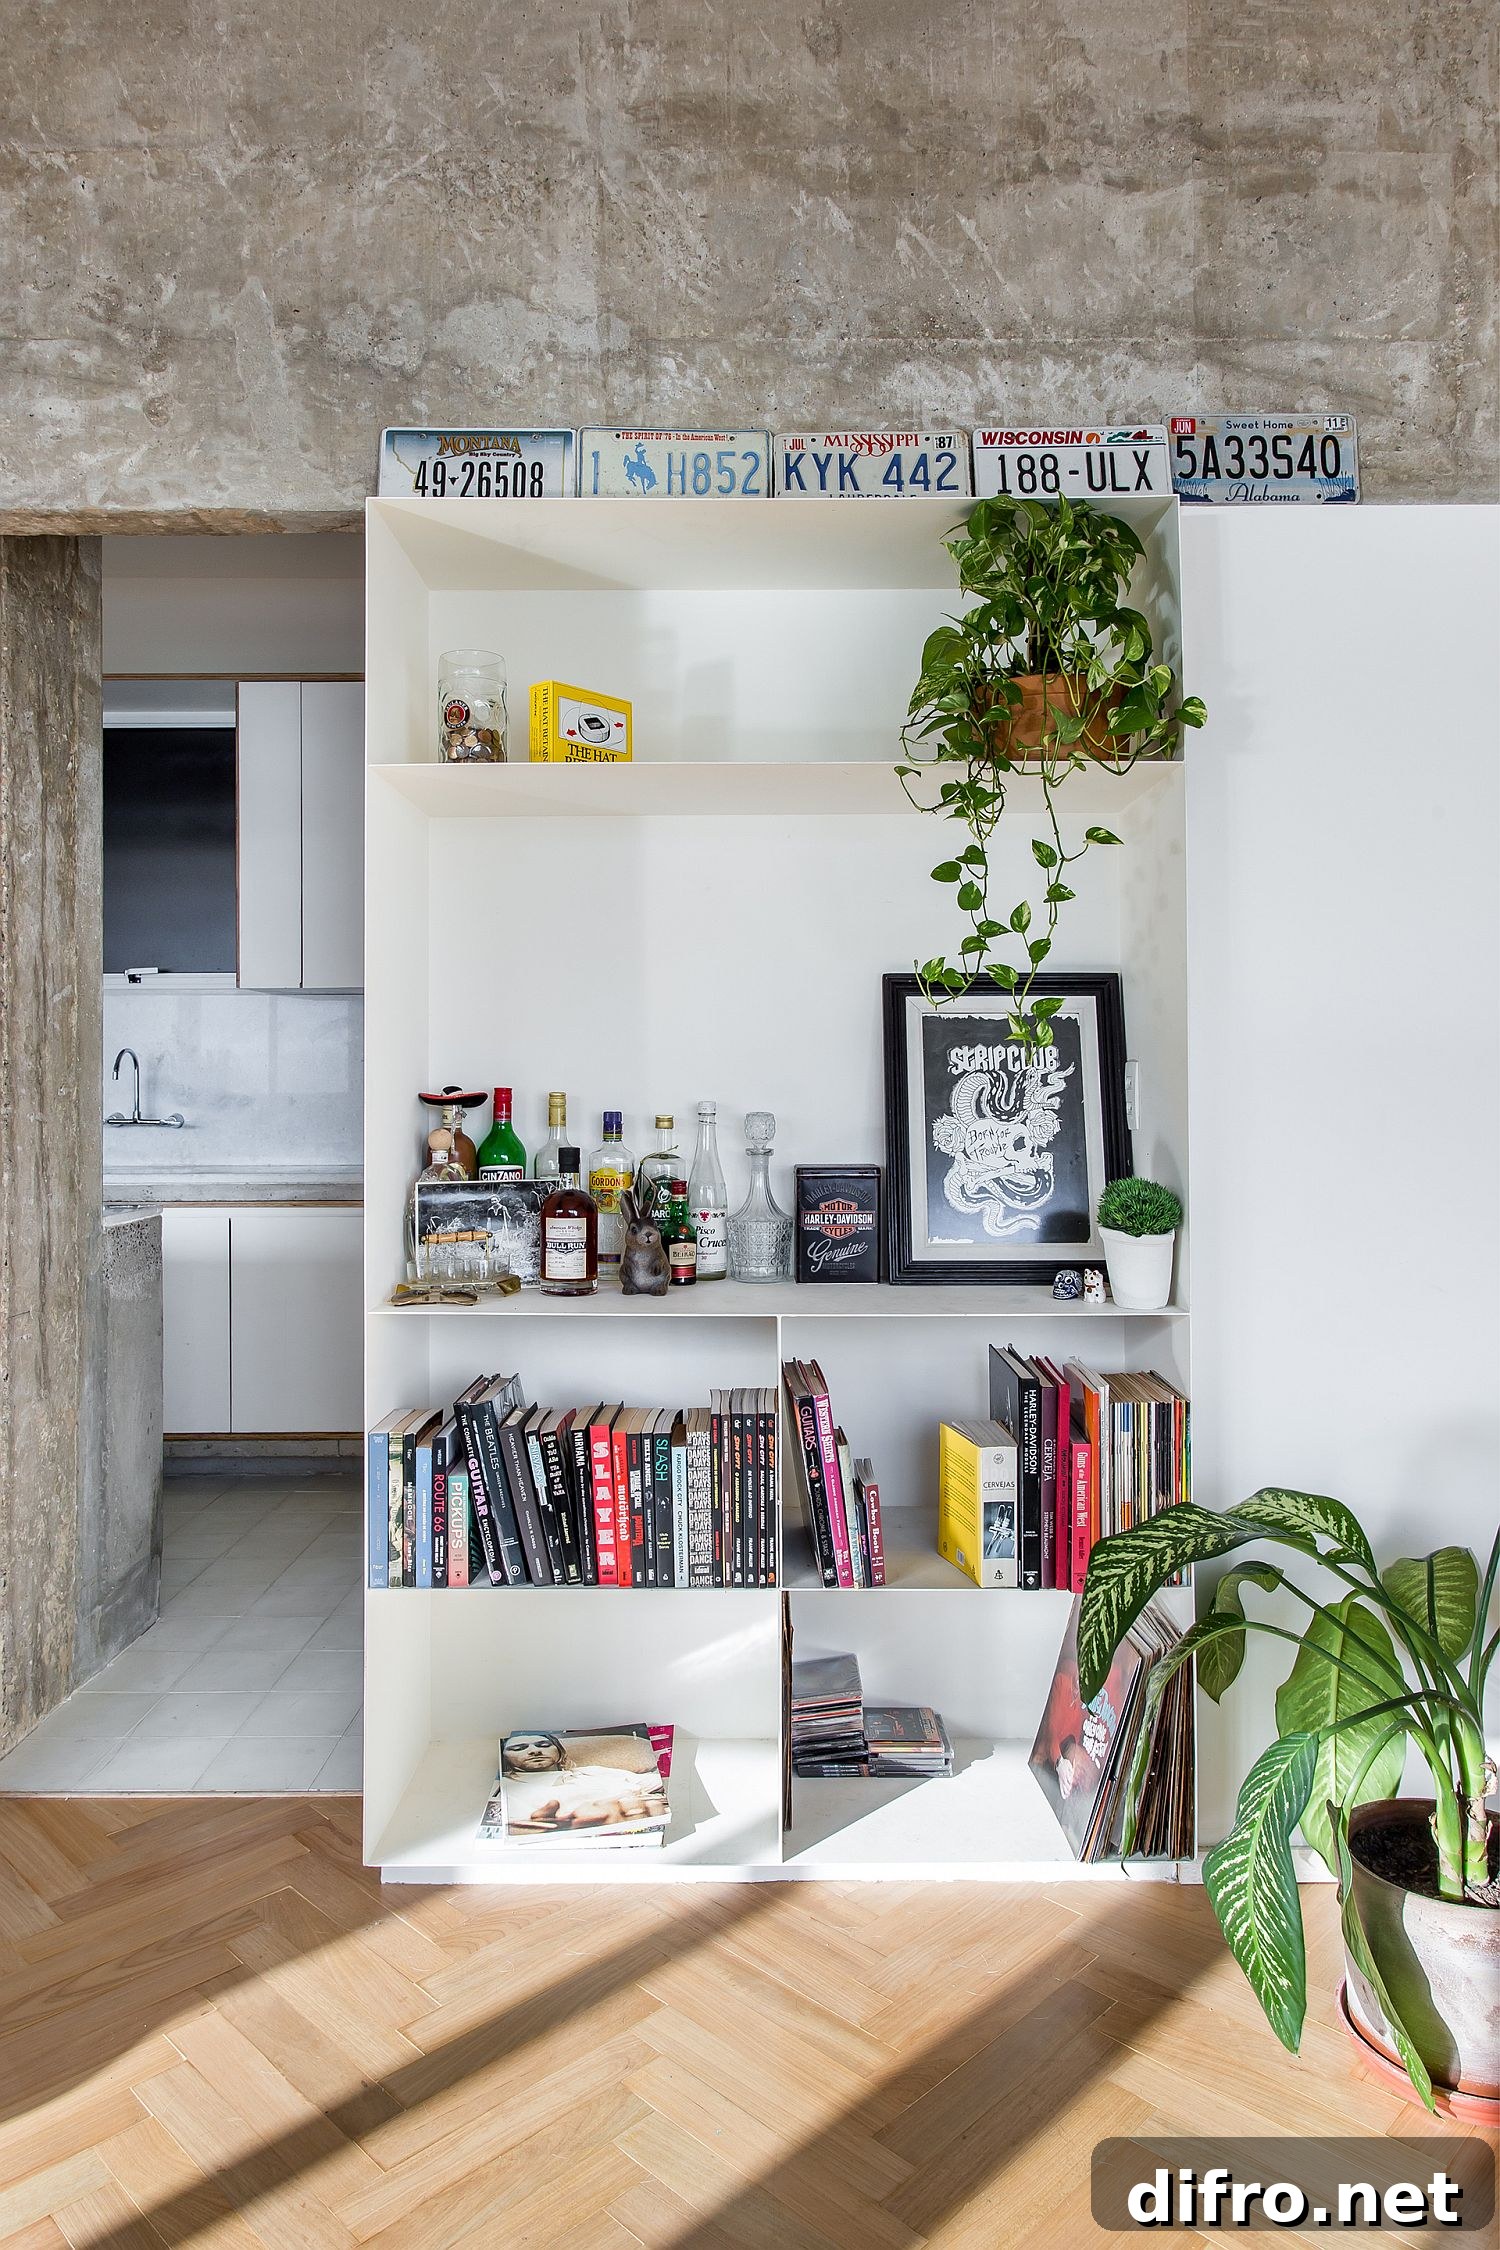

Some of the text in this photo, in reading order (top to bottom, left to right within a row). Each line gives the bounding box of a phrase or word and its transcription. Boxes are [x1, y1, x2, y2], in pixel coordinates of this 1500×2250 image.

[1173, 421, 1192, 434] JUN
[1226, 420, 1293, 430] Sweet Home
[1326, 418, 1338, 428] 11
[437, 435, 522, 456] MONTANA
[621, 431, 633, 439] THE
[634, 431, 654, 440] SPIRIT
[690, 433, 714, 441] American
[789, 434, 952, 457] JUL MISSISSIPPI 87
[981, 431, 1083, 446] WISCONSIN
[1175, 434, 1341, 480] 5A33S40
[415, 461, 544, 497] 49 26508
[592, 450, 760, 495] 1 H852
[784, 452, 959, 492] KYK 442
[997, 450, 1154, 495] 188-ULX
[1225, 483, 1301, 503] Alabama
[568, 743, 618, 762] THE HAT
[481, 1170, 521, 1181] CINZANO
[824, 1200, 853, 1211] MOTOR
[804, 1213, 873, 1225] HARLEY-DAVIDSON
[696, 1225, 716, 1235] Pisco
[824, 1226, 853, 1238] CYCLES
[807, 1238, 869, 1273] Genuine
[483, 1414, 491, 1426] THE
[816, 1399, 832, 1434] WESTERN
[693, 1437, 711, 1446] DAYS
[1028, 1389, 1037, 1474] HARLEY-DAVIDSON
[464, 1428, 475, 1458] COMPLETE
[485, 1428, 500, 1470] BEATLES
[508, 1433, 519, 1459] HEAVIER
[573, 1432, 585, 1467] NIRVANA
[687, 1448, 711, 1458] DANCE
[820, 1435, 835, 1464] SHIRTS
[513, 1460, 522, 1477] THAN
[656, 1438, 669, 1481] SLASH
[693, 1458, 711, 1467] DAYS
[1043, 1438, 1053, 1482] CERVEJA
[1076, 1452, 1089, 1468] Guns
[688, 1470, 711, 1479] DANCE
[693, 1479, 711, 1488] DAYS
[800, 1406, 817, 1451] GUITARS
[821, 1540, 830, 1556] STARS
[468, 1457, 489, 1517] GUITAR
[517, 1477, 527, 1502] HEAVEN
[688, 1491, 711, 1500] DANCE
[1076, 1480, 1088, 1511] American
[434, 1474, 445, 1532] ROUTE 66
[593, 1441, 616, 1566] SLAYER
[616, 1485, 630, 1541] motörhead
[694, 1500, 712, 1509] DAYS
[868, 1490, 879, 1526] Cowboy
[451, 1482, 464, 1549] PICKUPS
[689, 1512, 712, 1521] DANCE
[694, 1521, 712, 1530] DAYS
[1076, 1511, 1088, 1528] West
[631, 1515, 643, 1546] PANTERA
[689, 1533, 712, 1543] DANCE
[872, 1527, 880, 1553] Boots
[481, 1519, 496, 1563] ENCYCLOPEDIA
[695, 1543, 712, 1552] DAYS
[690, 1555, 713, 1564] DANCE
[690, 1576, 713, 1585] DANCE
